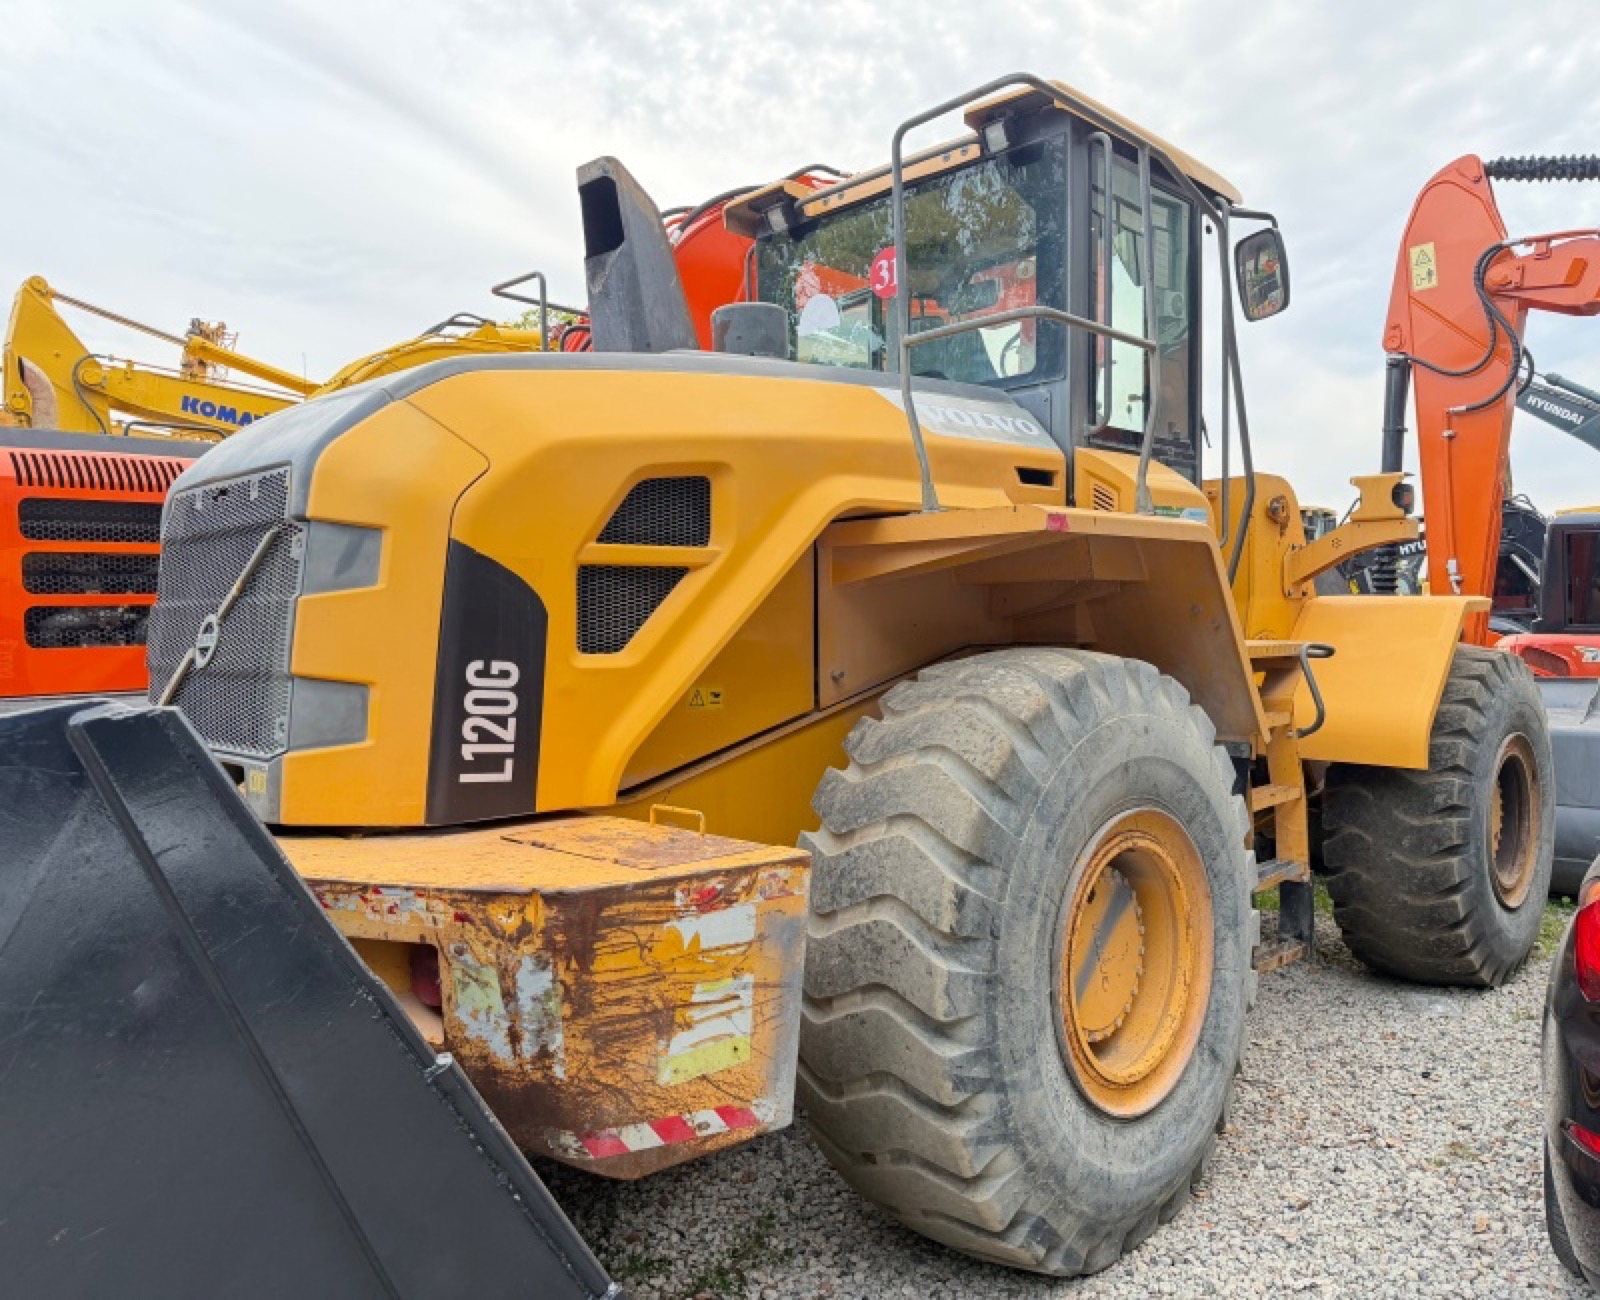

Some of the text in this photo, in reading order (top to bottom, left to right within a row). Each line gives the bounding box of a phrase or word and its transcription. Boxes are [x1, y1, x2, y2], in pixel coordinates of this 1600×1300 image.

[181, 395, 263, 426] KOMA
[915, 403, 1039, 435] VOLVO
[1527, 394, 1584, 425] HYUNDAI
[459, 659, 520, 783] L120G
